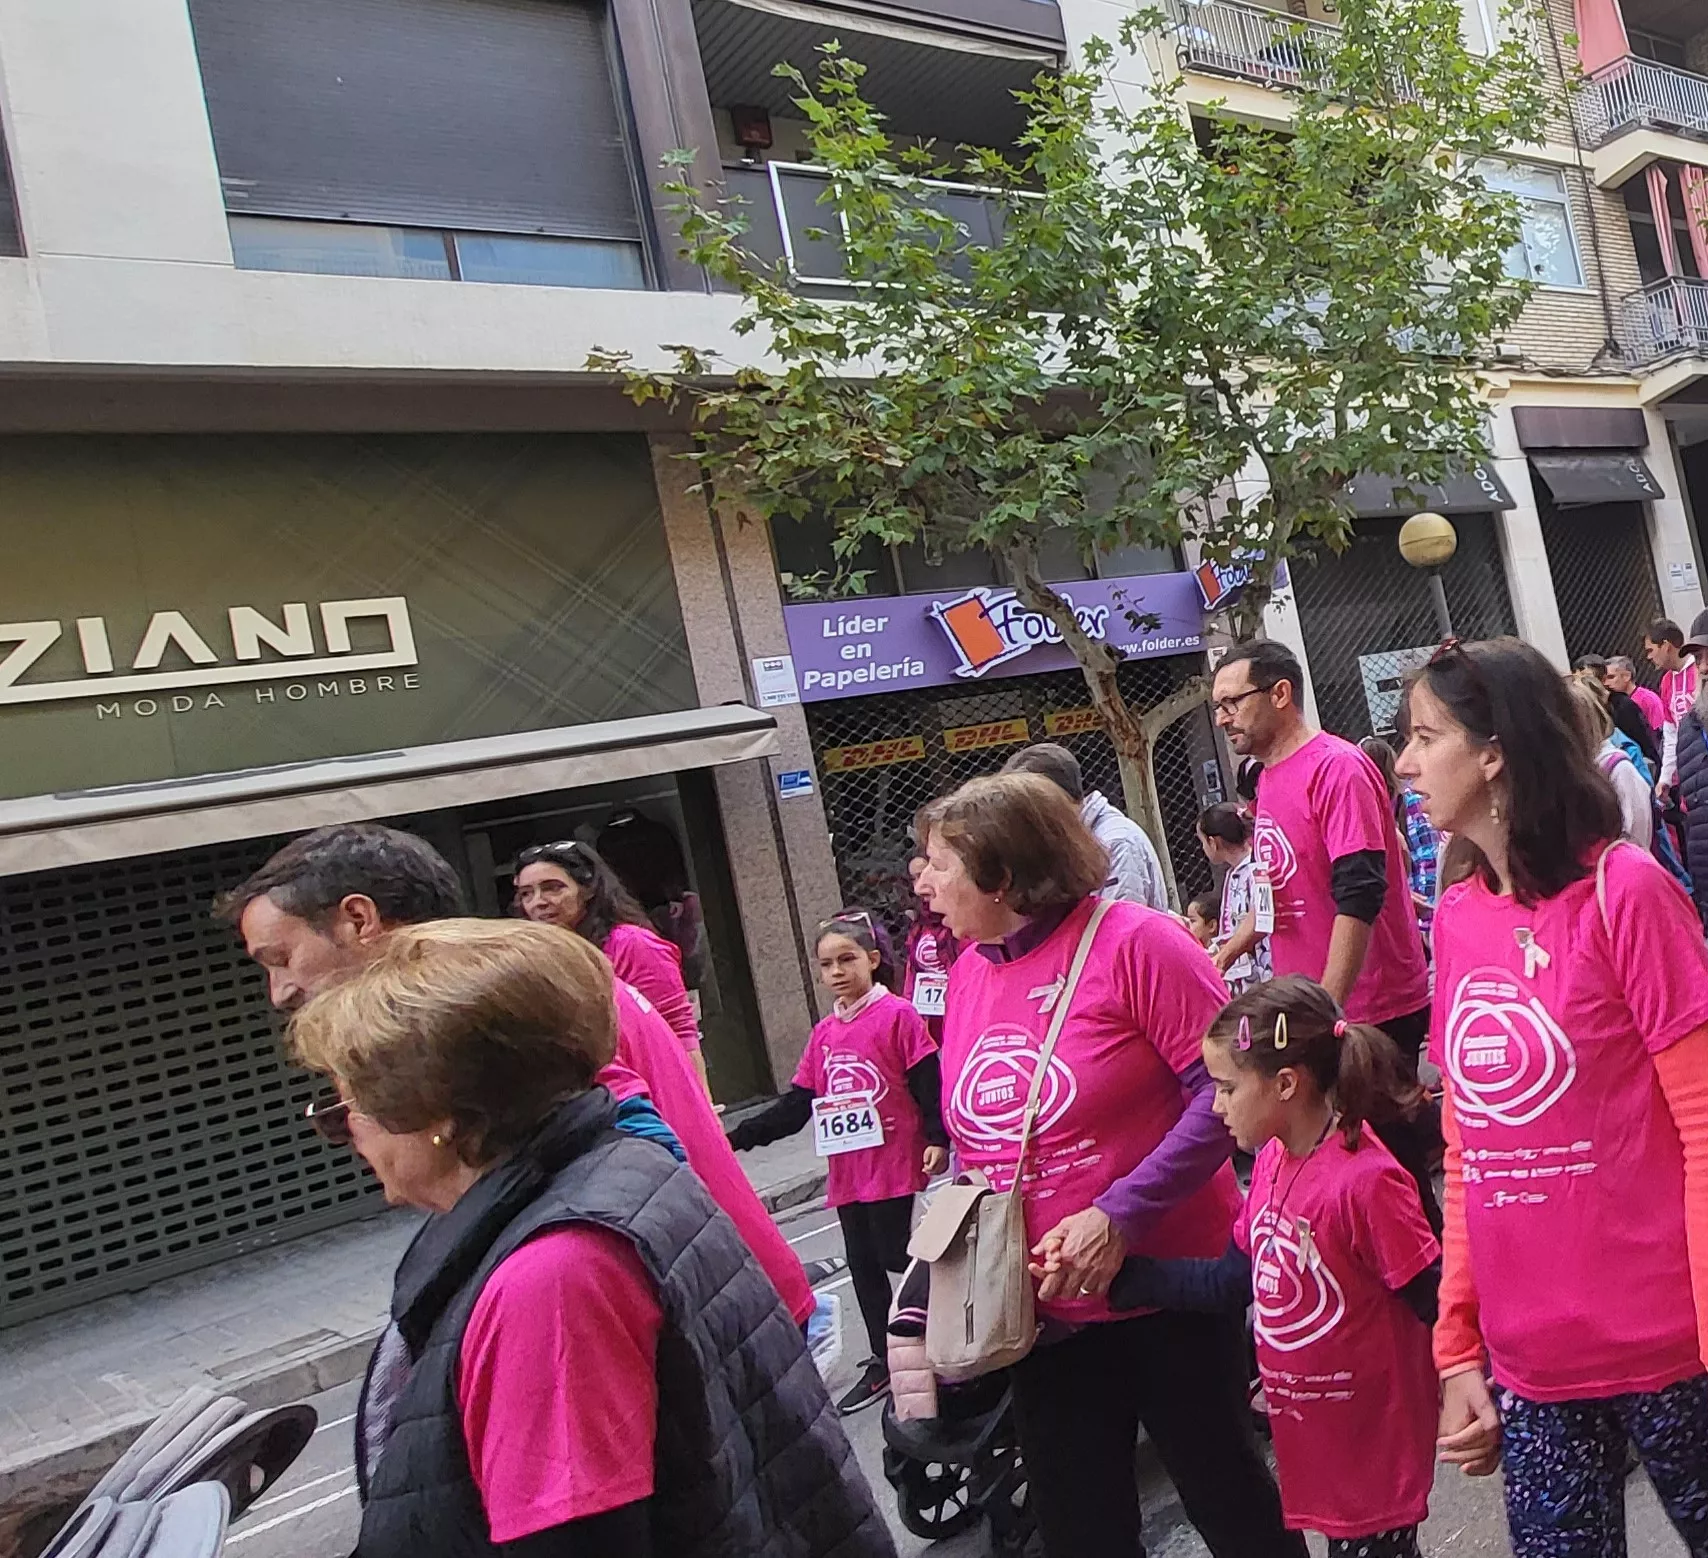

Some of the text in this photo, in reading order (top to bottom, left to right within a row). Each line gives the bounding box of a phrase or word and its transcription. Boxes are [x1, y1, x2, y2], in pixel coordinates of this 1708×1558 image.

[823, 615, 888, 637] Líder
[840, 642, 872, 660] en
[803, 656, 924, 690] Papelería
[97, 673, 421, 720] MODA HOMBRE
[953, 722, 1018, 748] DHL
[819, 1109, 875, 1139] 1684
